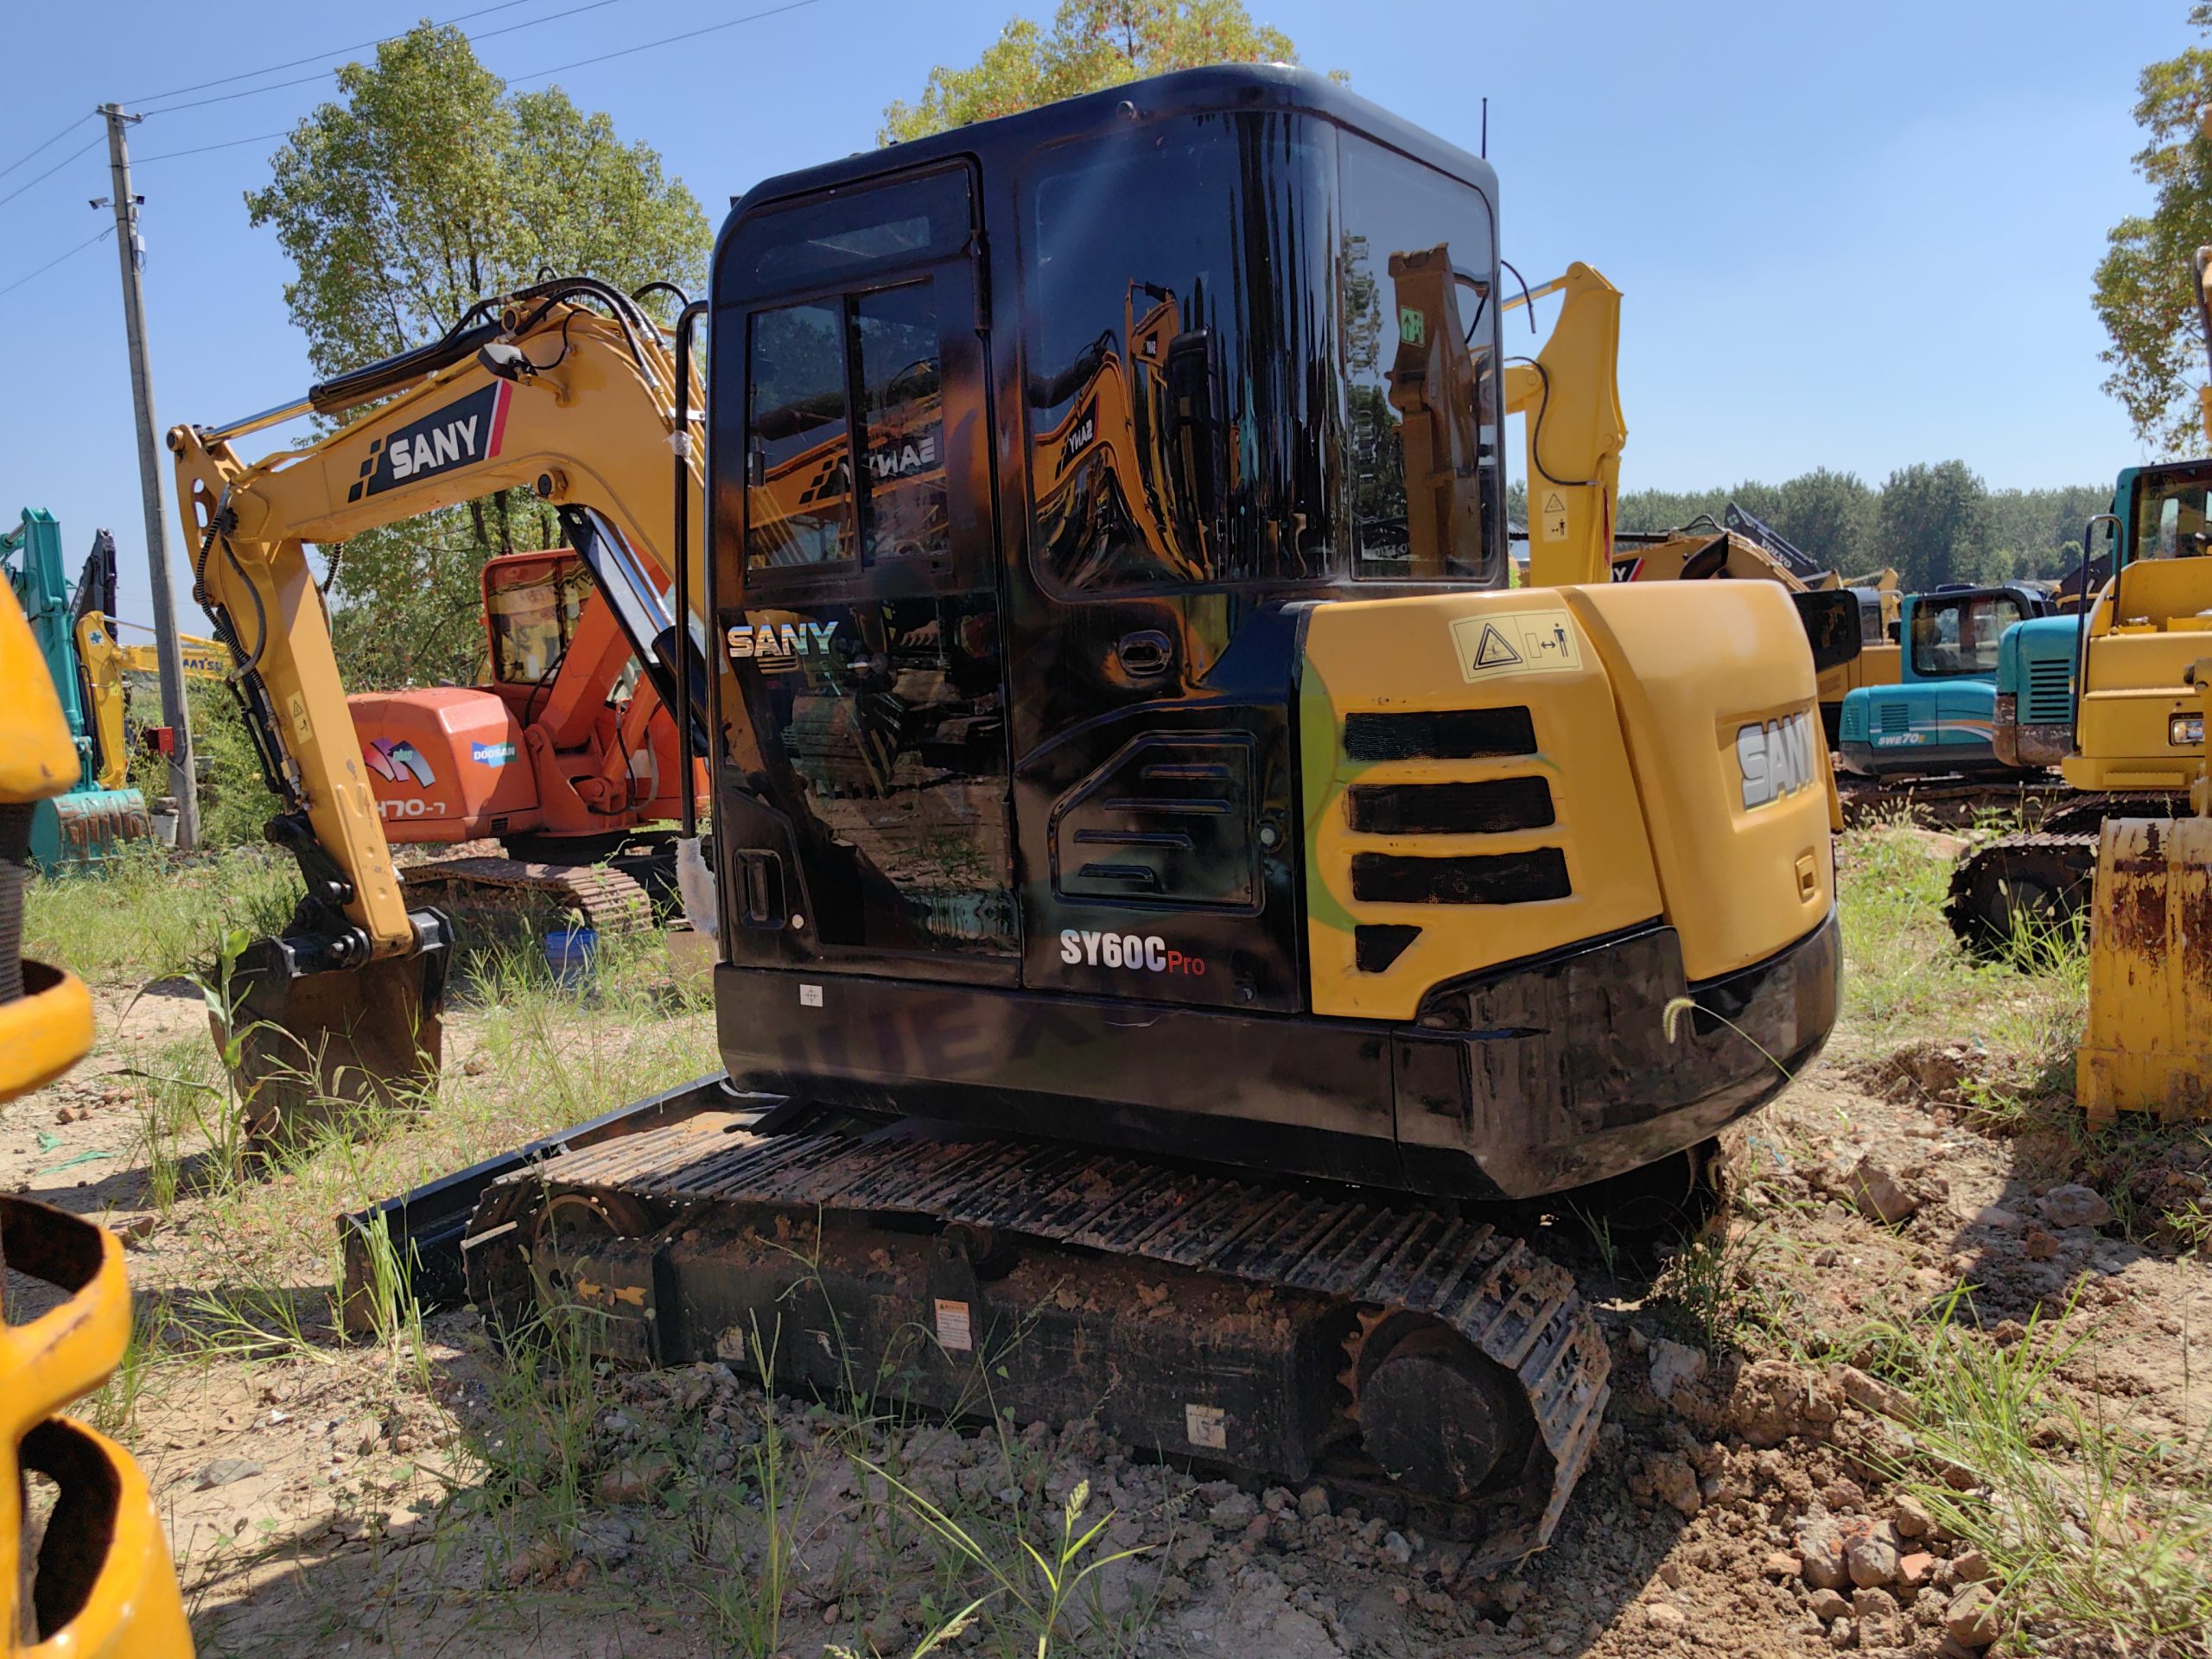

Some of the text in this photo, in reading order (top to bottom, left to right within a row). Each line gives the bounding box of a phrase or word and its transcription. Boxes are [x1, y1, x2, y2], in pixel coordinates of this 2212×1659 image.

[390, 415, 478, 480] SANY
[1761, 537, 1793, 569] VOLVO
[728, 621, 839, 658] SANY
[392, 748, 413, 762] plus
[474, 746, 516, 760] DOOSAN
[1736, 711, 1814, 809] SANY
[375, 798, 447, 817] H70-7
